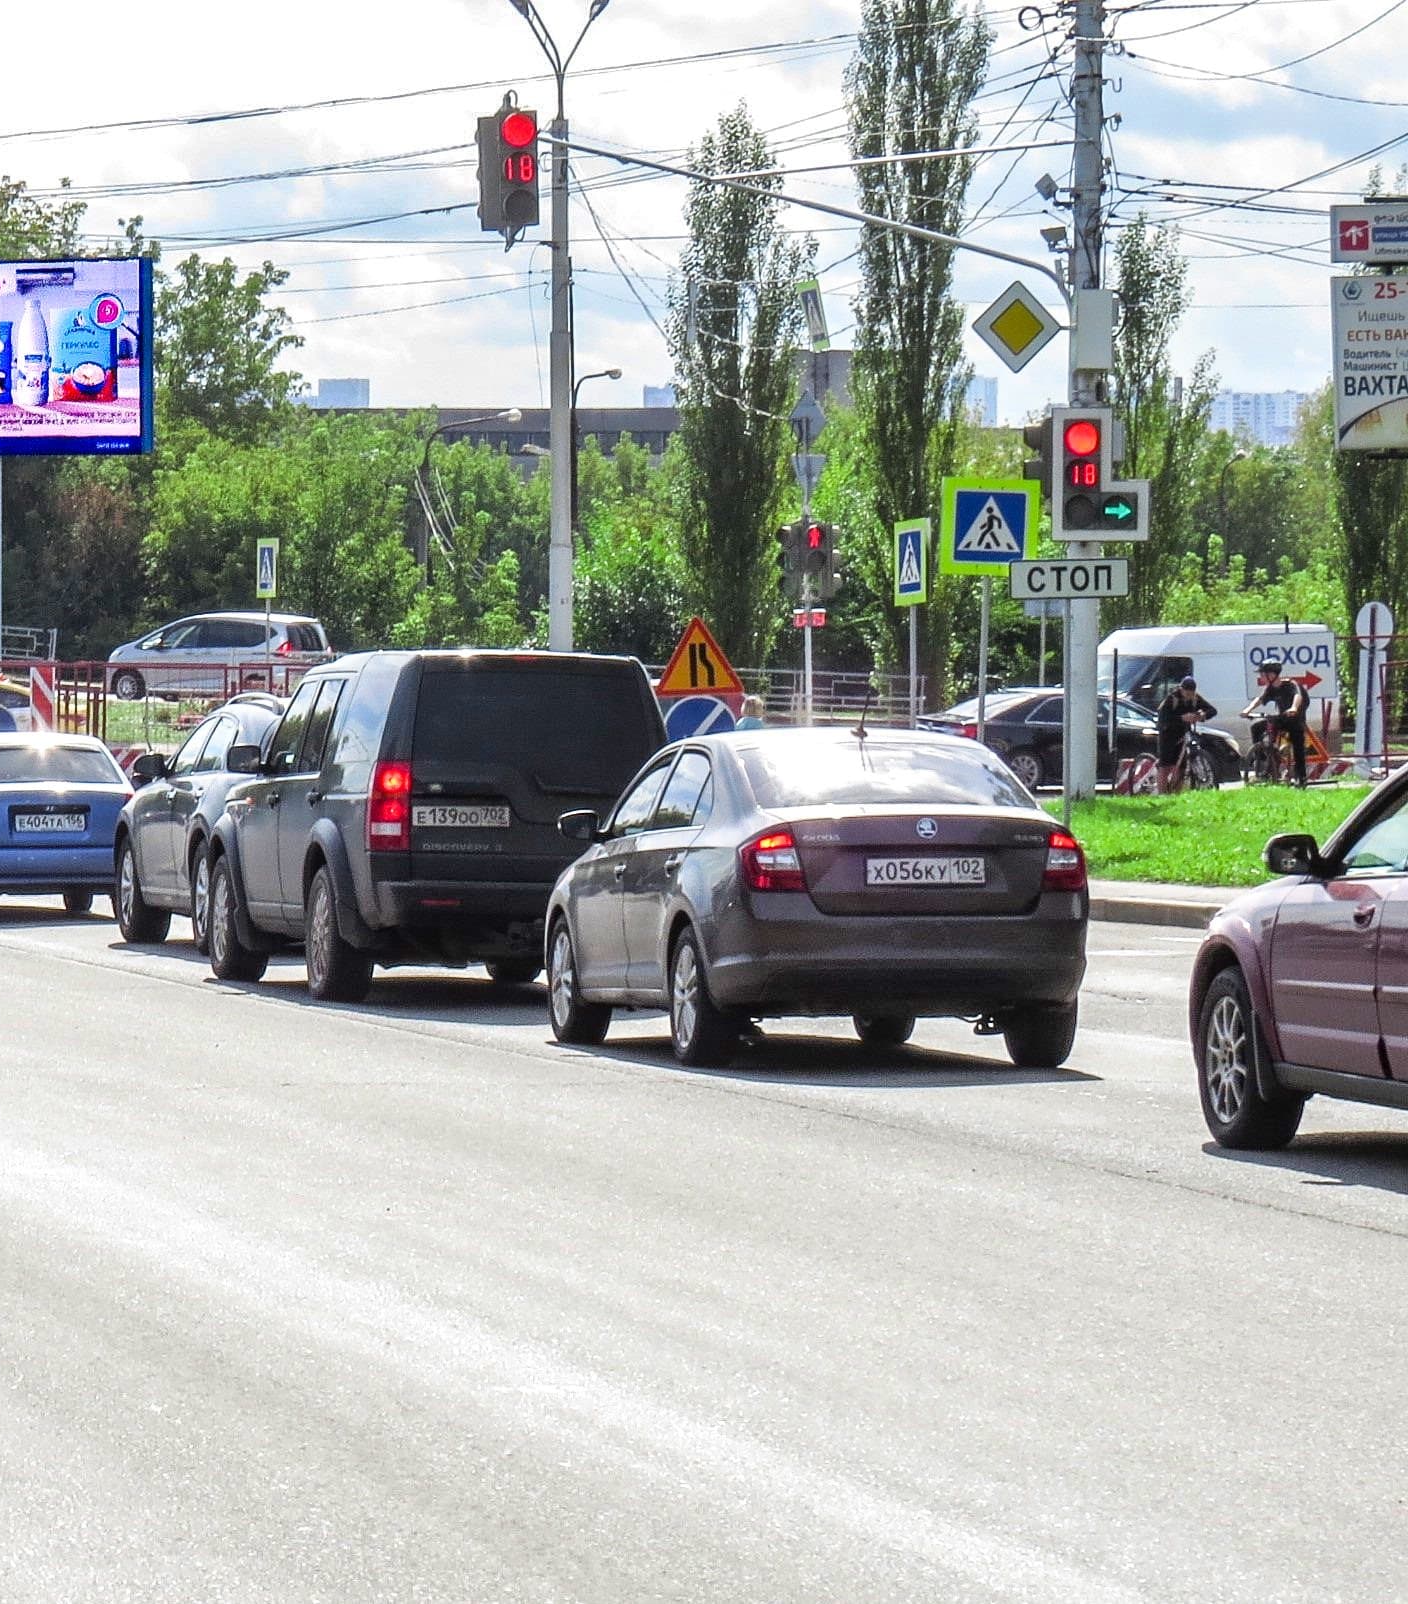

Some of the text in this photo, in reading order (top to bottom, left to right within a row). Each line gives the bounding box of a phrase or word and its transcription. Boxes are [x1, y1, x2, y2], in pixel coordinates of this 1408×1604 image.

[507, 154, 533, 183] 18
[1374, 282, 1408, 299] 25-
[1358, 310, 1406, 322] Ищешь
[1347, 330, 1381, 341] ЕСТЬ
[1343, 349, 1392, 360] Водитель
[1343, 361, 1398, 371] Машинист
[1344, 375, 1408, 396] ВАХТА
[1072, 463, 1096, 487] 18
[1027, 564, 1112, 592] СТОП
[1250, 645, 1331, 668] ОБХОД
[874, 860, 980, 880] Х056КУ 102
